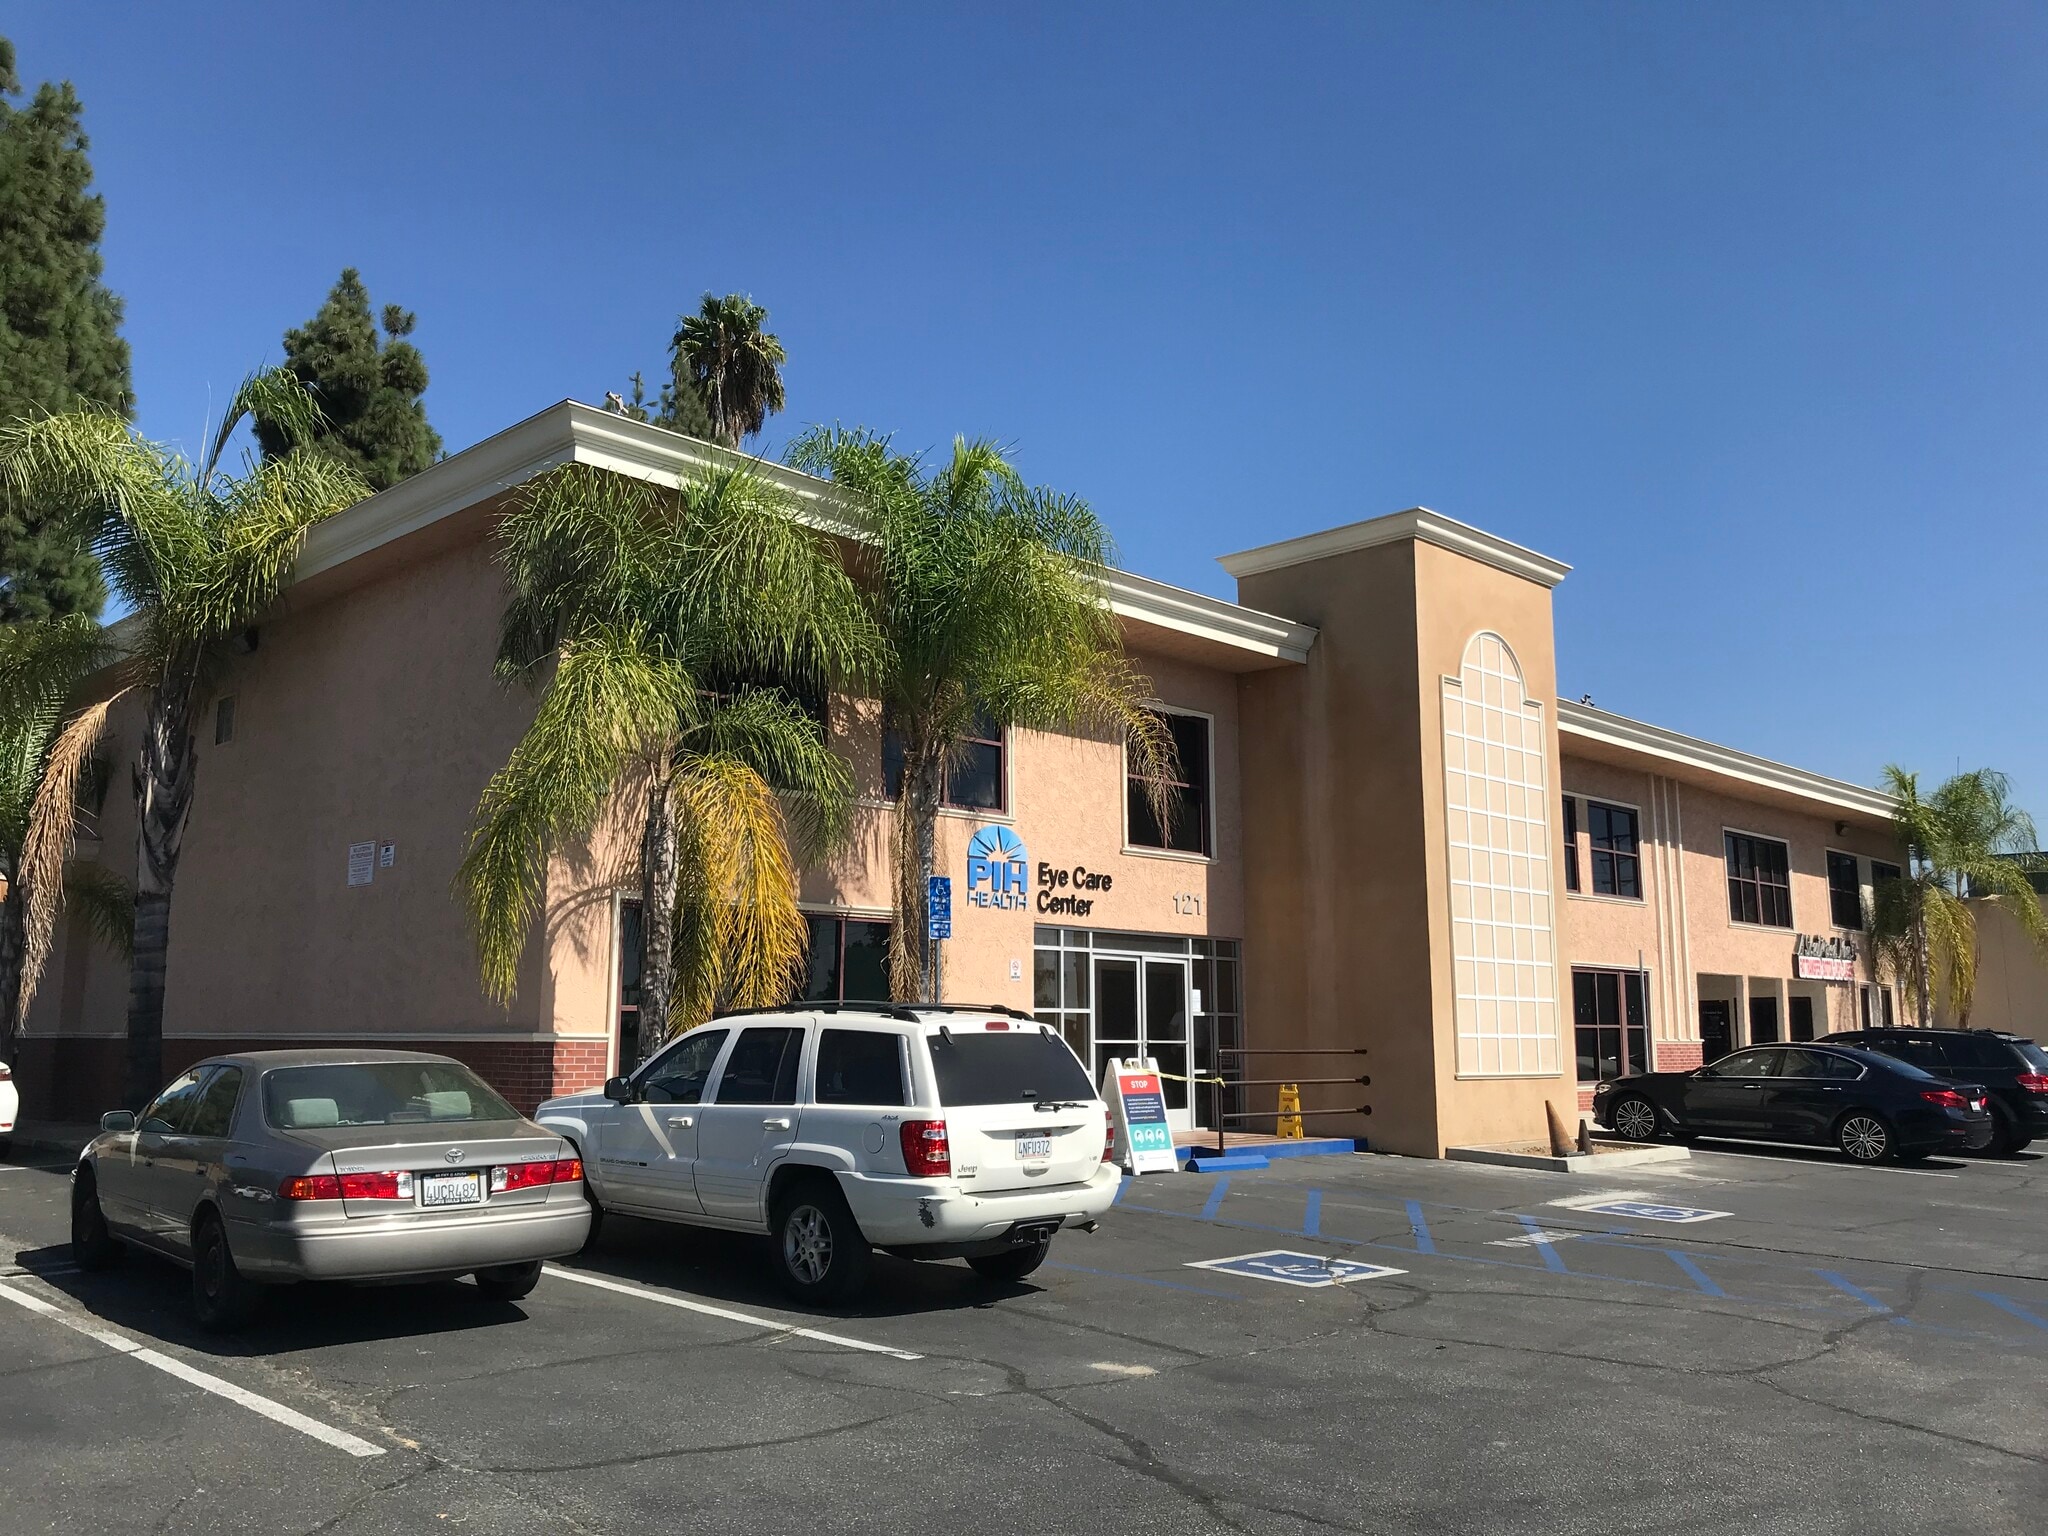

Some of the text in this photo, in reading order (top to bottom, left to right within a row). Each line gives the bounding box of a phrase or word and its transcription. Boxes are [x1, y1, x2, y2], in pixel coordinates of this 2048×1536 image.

[967, 857, 1028, 894] PIH
[1037, 862, 1112, 892] Eye Care
[967, 890, 1028, 911] HEALTH
[1036, 890, 1094, 917] Center
[1173, 891, 1202, 916] 121
[1130, 1080, 1149, 1089] STOP
[1018, 1140, 1050, 1155] 4NFU372
[958, 1164, 978, 1173] Jeep
[426, 1183, 476, 1200] 4UCR489
